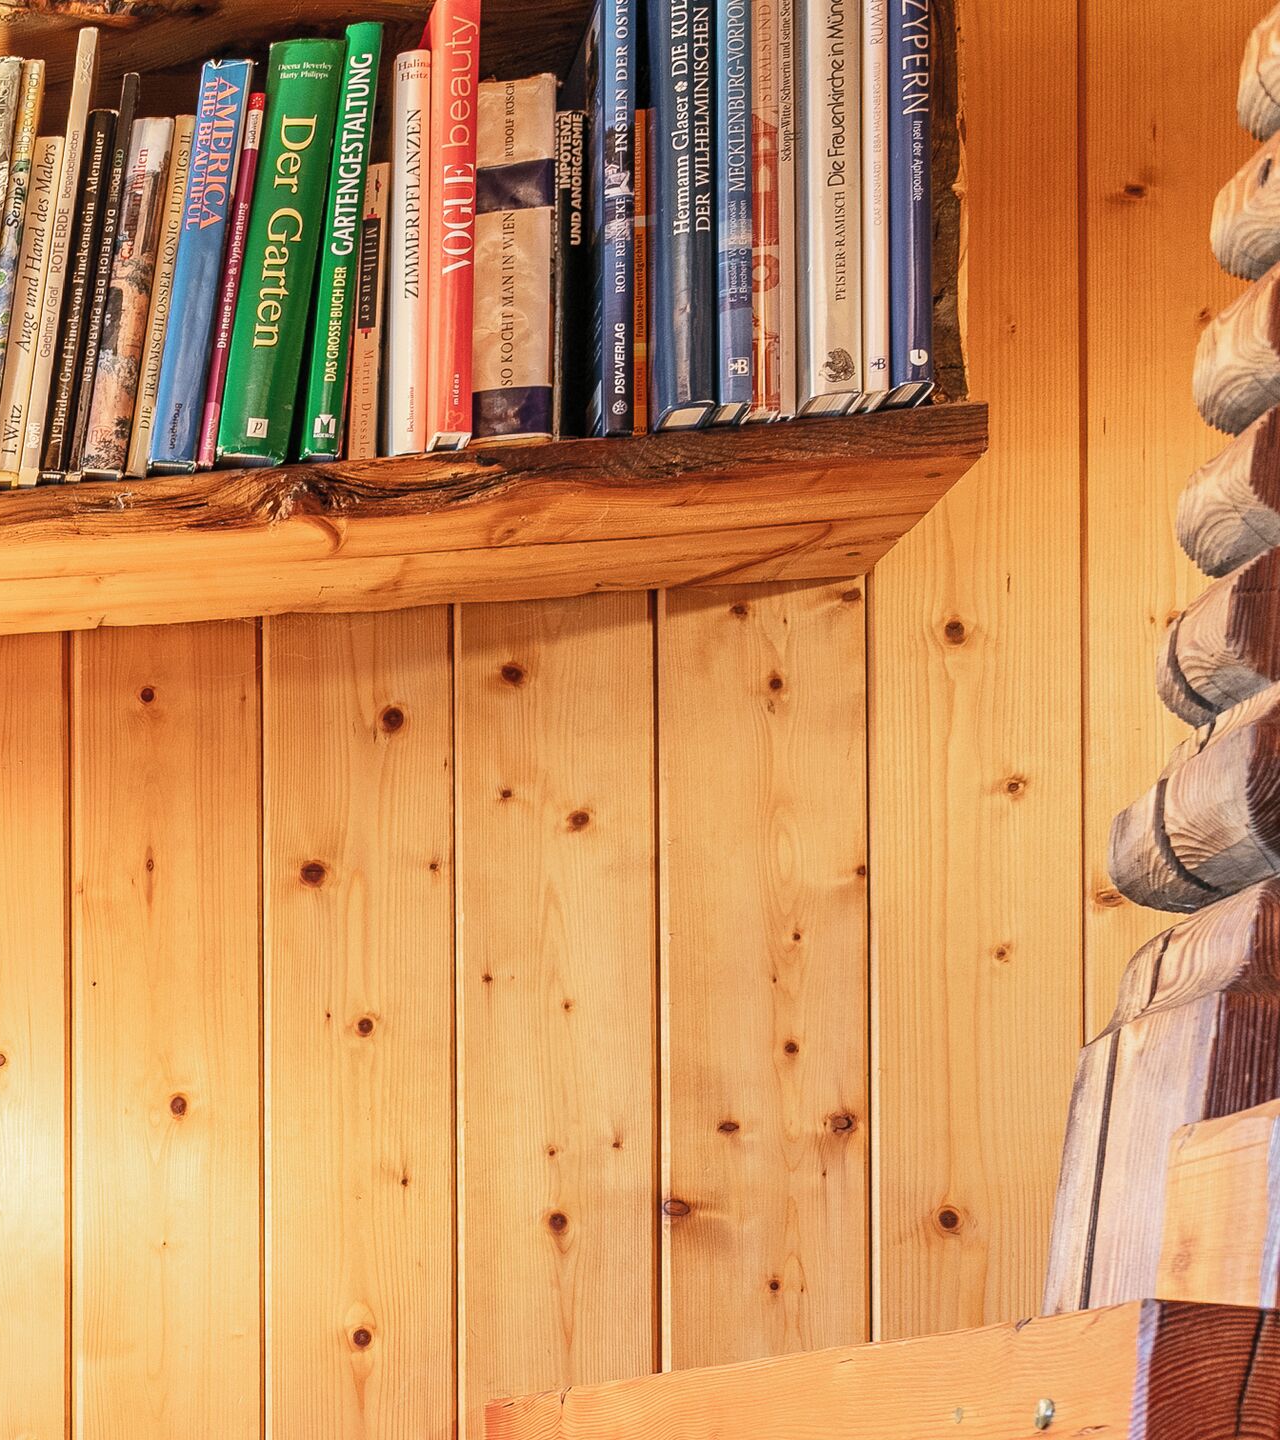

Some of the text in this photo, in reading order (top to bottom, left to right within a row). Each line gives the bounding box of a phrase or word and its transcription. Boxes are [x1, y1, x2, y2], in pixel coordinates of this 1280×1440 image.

[185, 82, 219, 231] THE BEAUTIFUL
[199, 77, 240, 231] AMERICA
[441, 15, 479, 277] VOGUE beauty
[672, 95, 691, 237] Hermann Glaser
[694, 5, 711, 233] DER WILHELMINISCHEN
[826, 60, 847, 189] Die Frauenkirche
[15, 143, 58, 354] Auge und Hand des Malers
[98, 237, 113, 276] REICH
[104, 208, 117, 233] DAS
[253, 113, 318, 349] Der Garten
[324, 52, 373, 383] DAS GROSSE BUCH DER GARTENGESTALTUNG
[404, 108, 422, 300] ZIMMERPFLANZEN
[569, 216, 582, 247] UND
[94, 279, 106, 303] DER
[500, 212, 515, 387] SO KOCHT MAN IN WIEN
